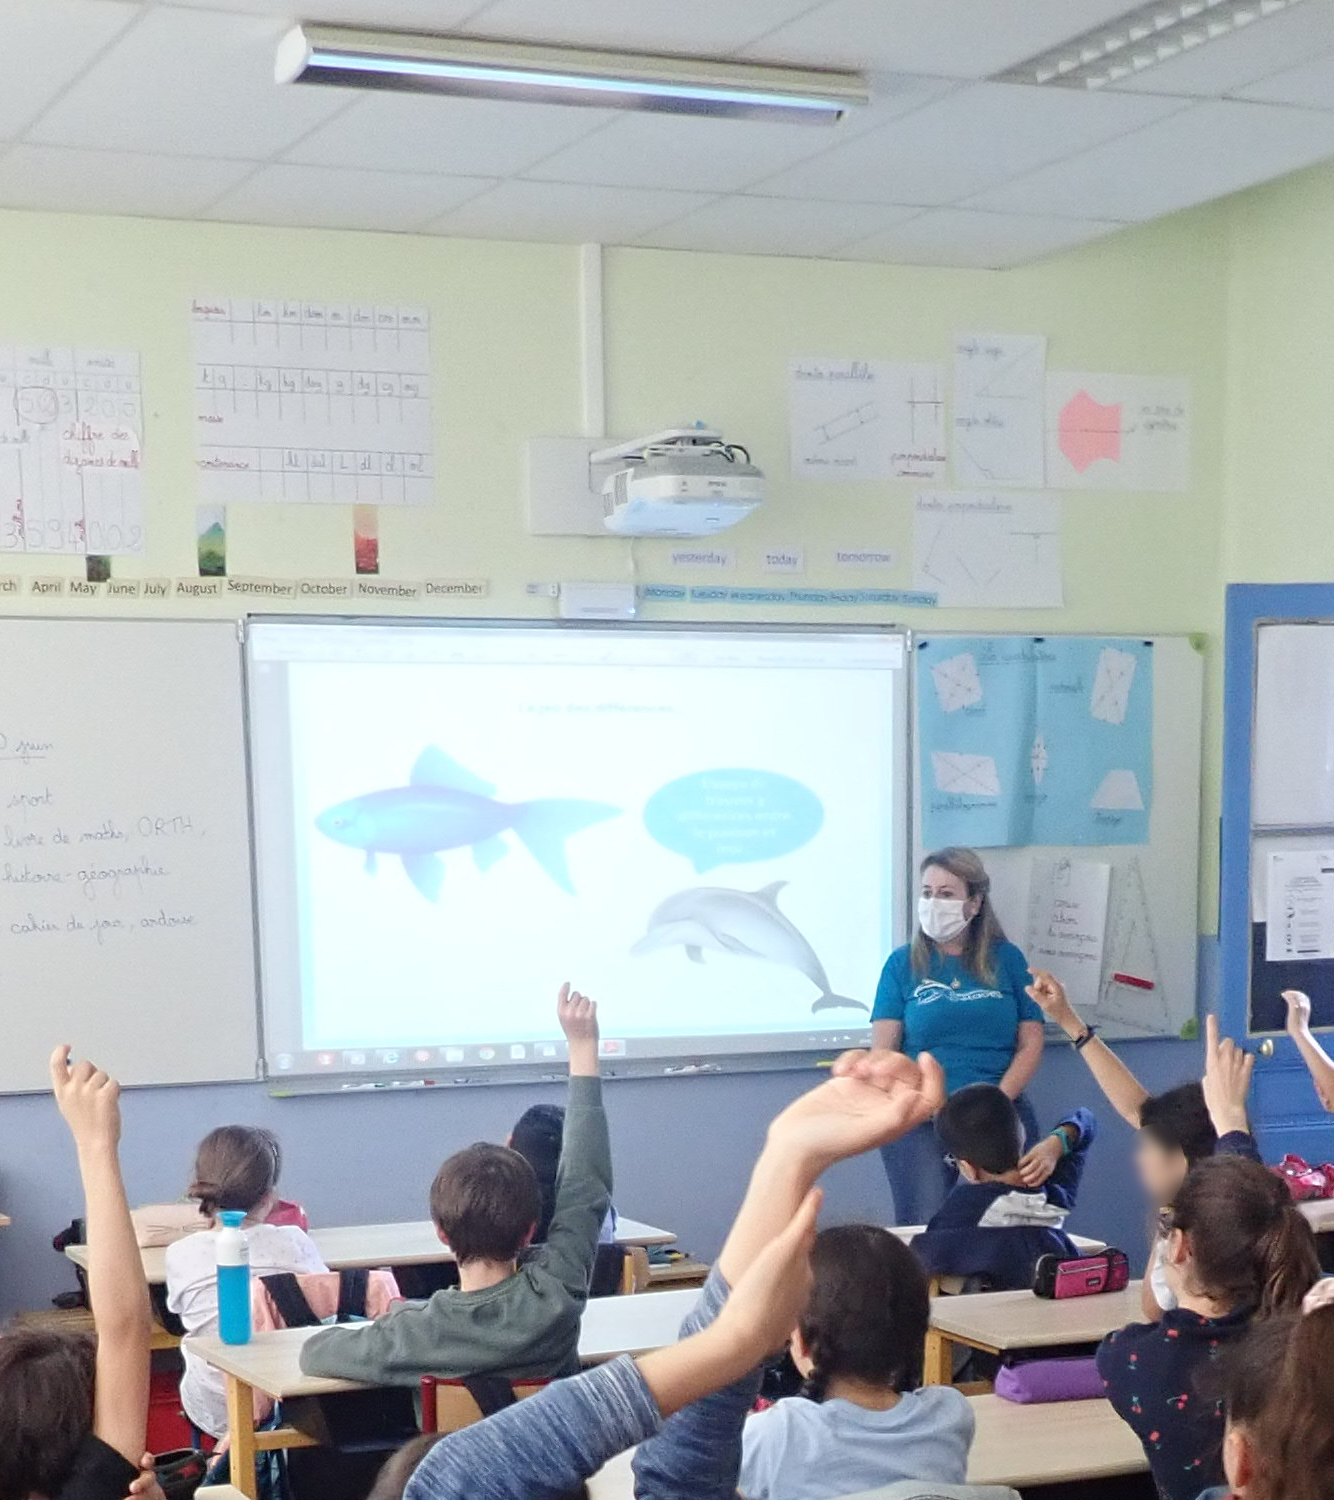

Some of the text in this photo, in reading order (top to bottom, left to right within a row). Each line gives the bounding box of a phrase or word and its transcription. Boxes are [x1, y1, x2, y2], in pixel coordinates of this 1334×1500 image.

[672, 551, 727, 566] yesterday
[766, 554, 798, 567] today
[836, 551, 891, 563] tomorrow
[31, 580, 61, 594] April
[69, 579, 97, 595] May
[107, 579, 135, 594] June
[143, 579, 166, 596] July
[176, 582, 217, 596] August
[226, 579, 293, 594] September
[300, 582, 347, 595] October
[358, 582, 417, 597] November
[425, 582, 483, 595] December
